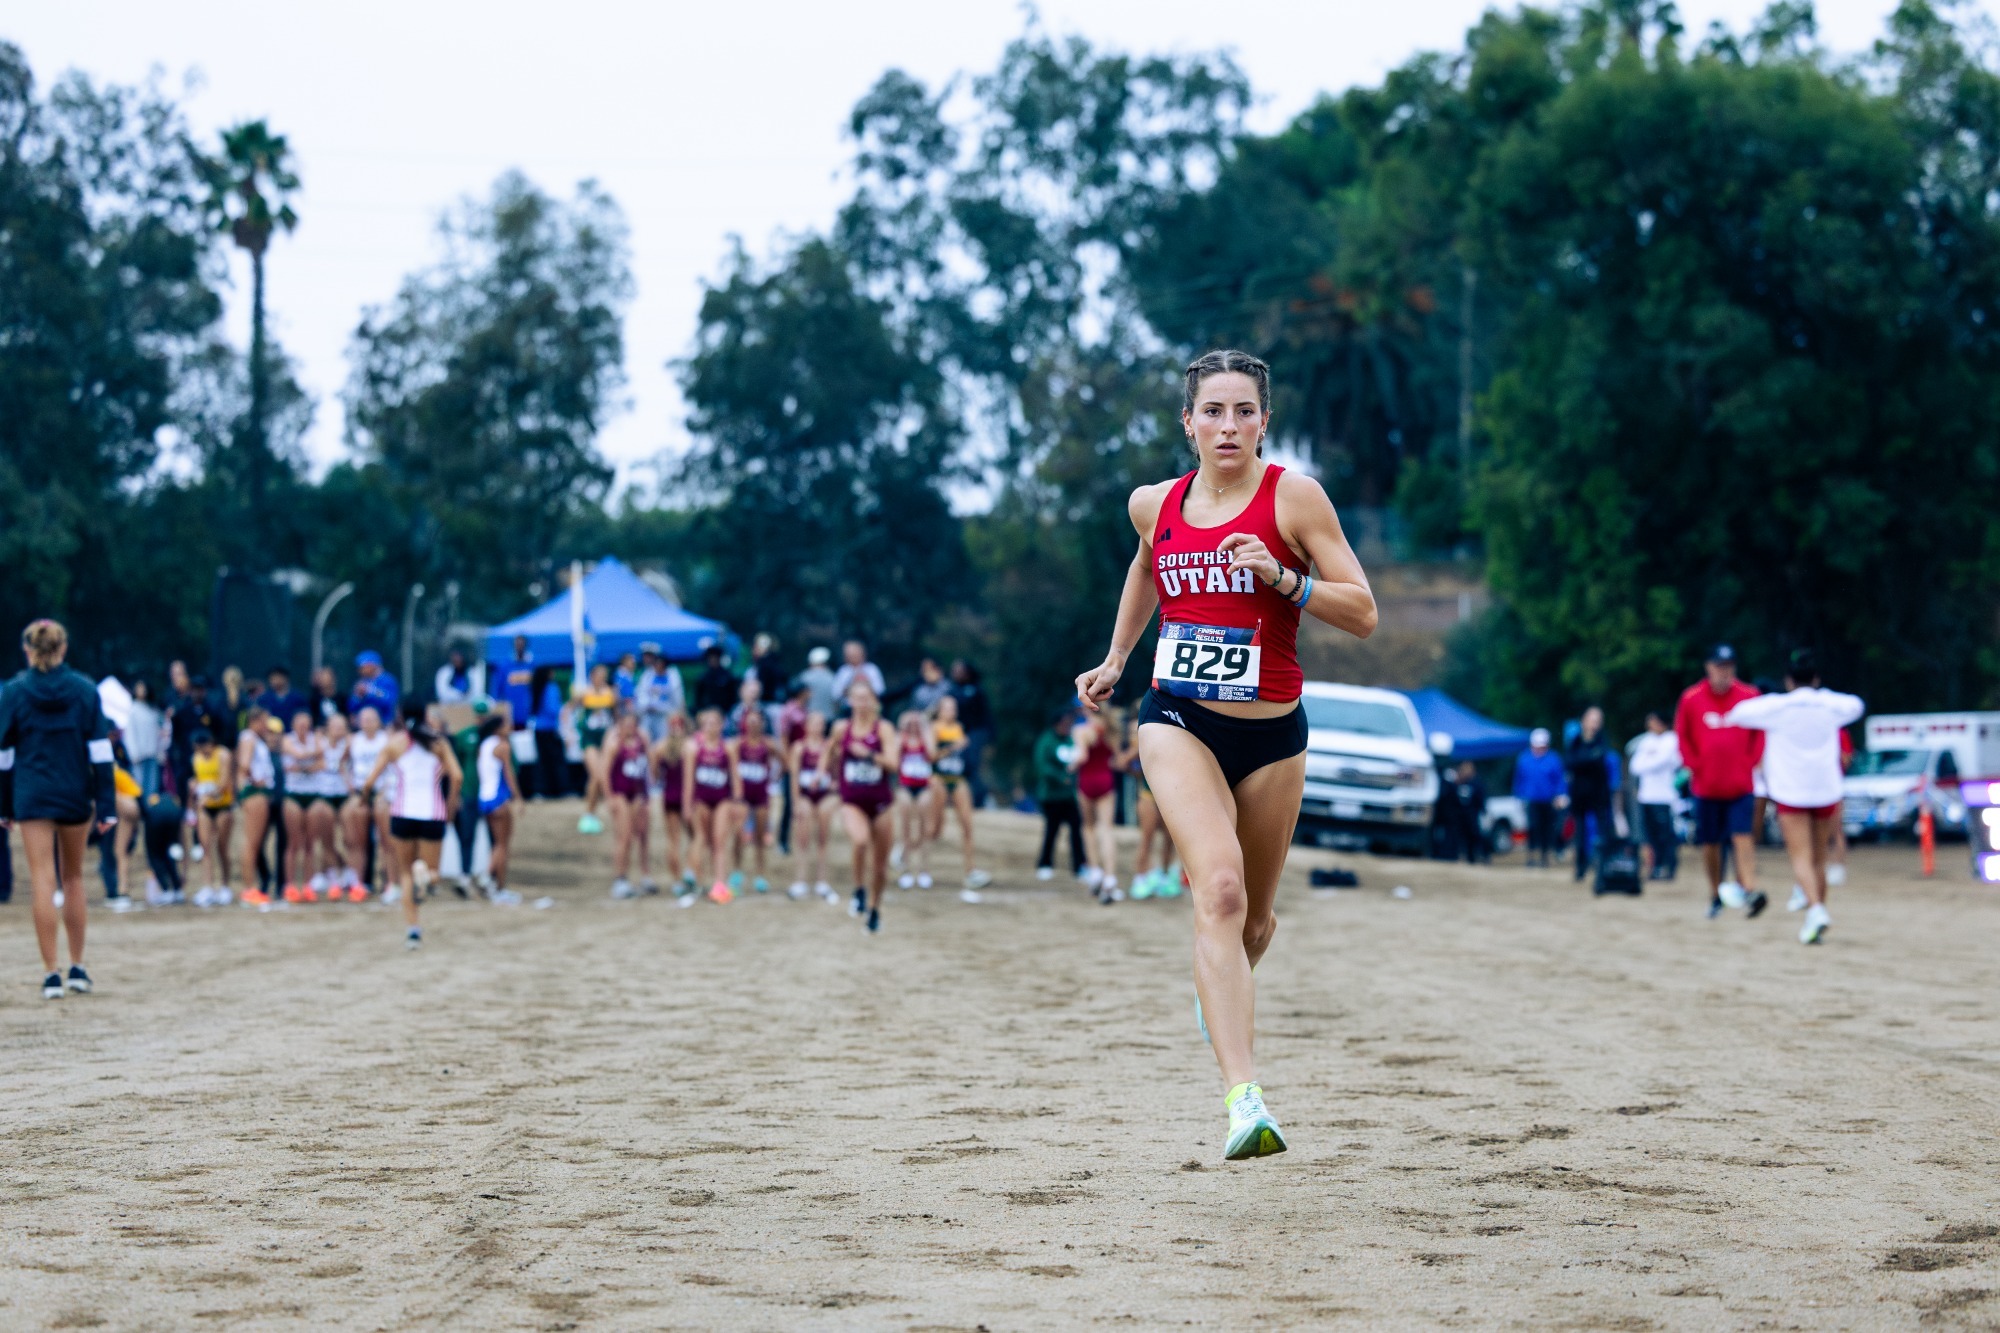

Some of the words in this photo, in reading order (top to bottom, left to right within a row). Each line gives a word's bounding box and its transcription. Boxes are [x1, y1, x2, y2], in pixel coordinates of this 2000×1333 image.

[1159, 566, 1255, 597] UTAH
[1195, 634, 1224, 643] RESULTS
[1197, 627, 1226, 636] FINISHED
[1170, 642, 1251, 682] 829
